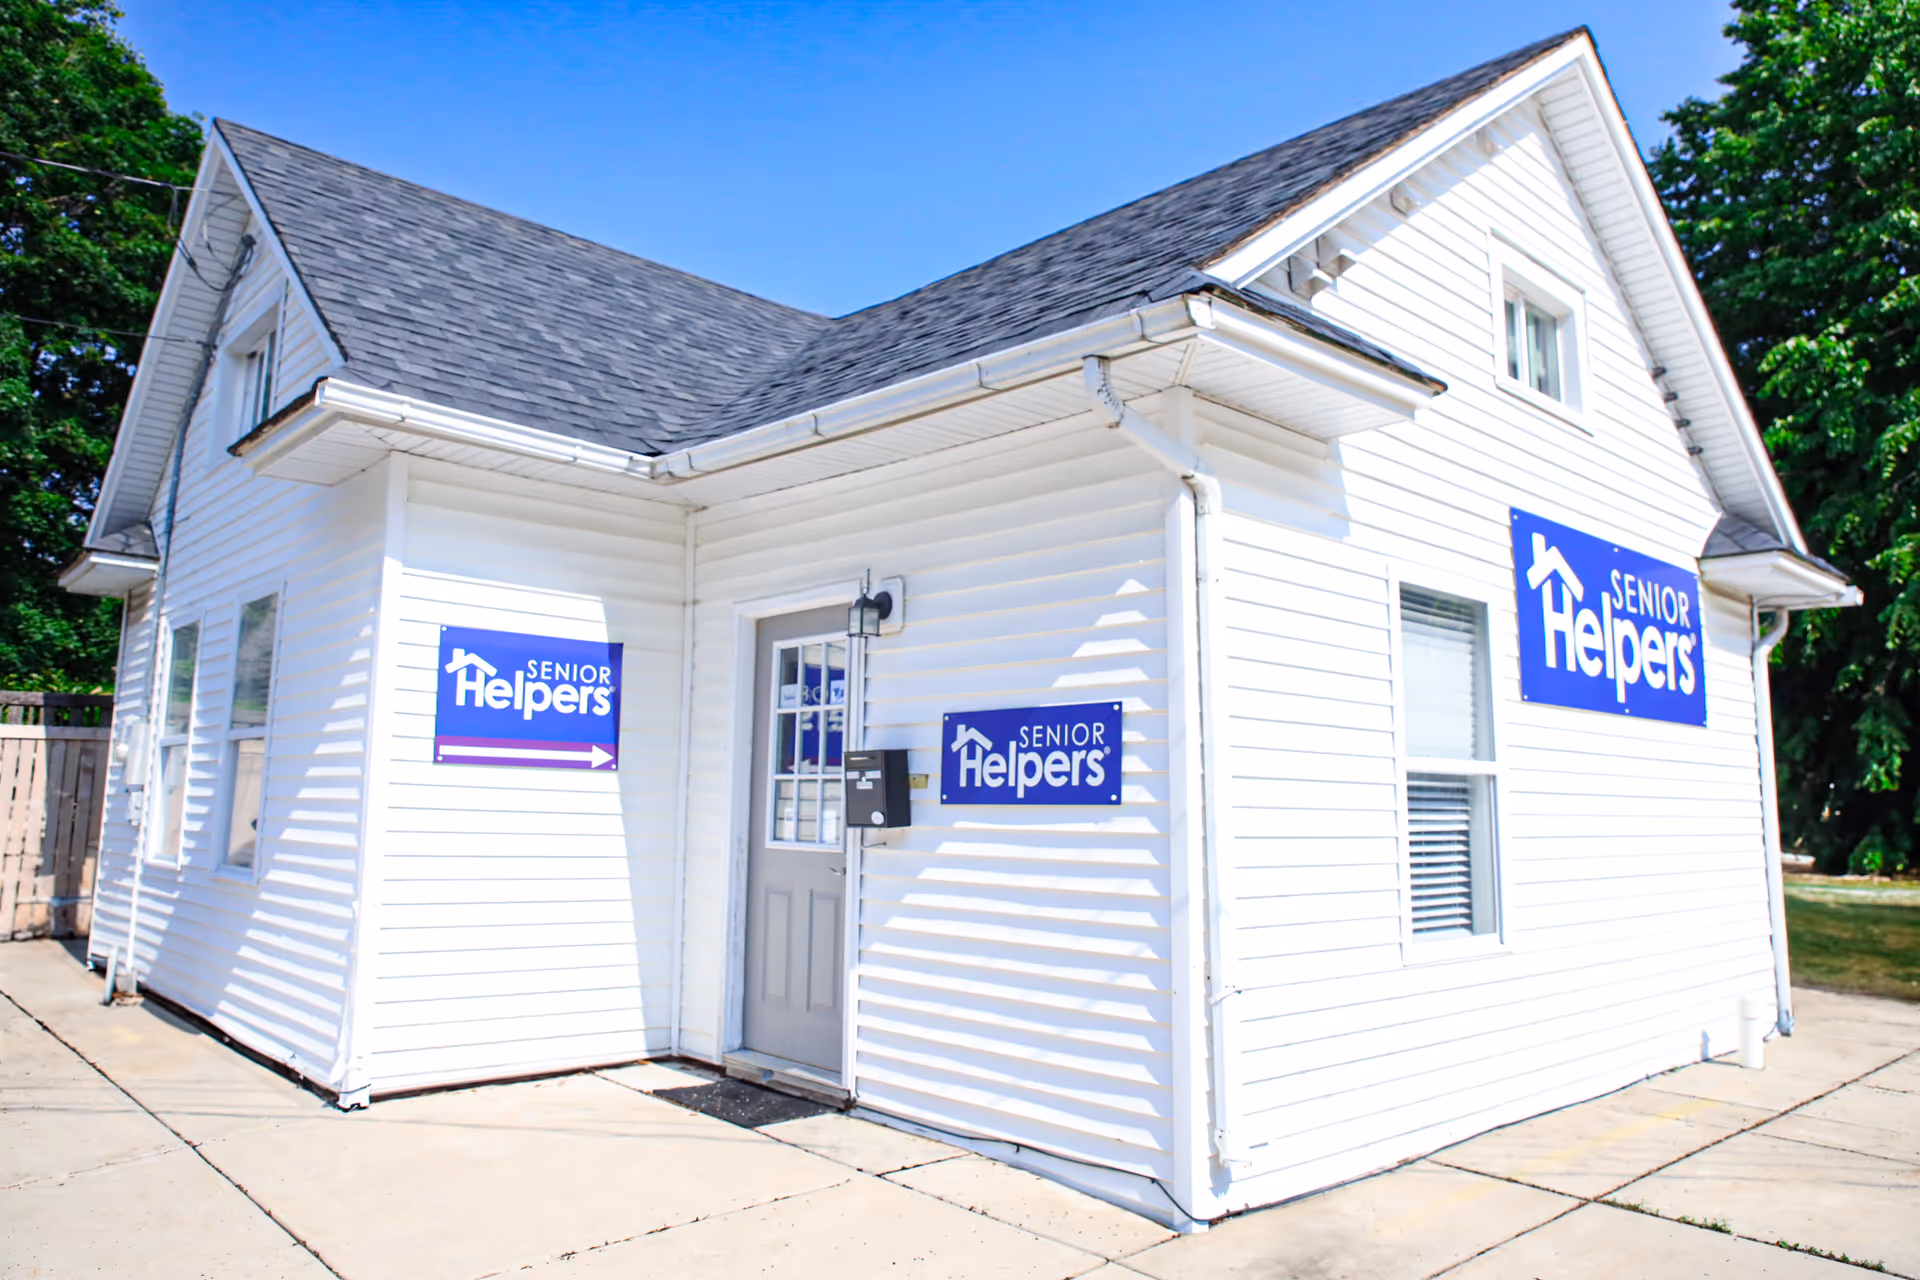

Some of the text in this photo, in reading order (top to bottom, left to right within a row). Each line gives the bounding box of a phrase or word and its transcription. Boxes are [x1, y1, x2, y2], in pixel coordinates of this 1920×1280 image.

[1610, 569, 1691, 629] SENIOR
[1541, 578, 1696, 704] Helpers
[455, 667, 612, 721] Helpers
[526, 659, 612, 685] SENIOR
[1019, 722, 1105, 749] SENIOR
[959, 740, 1106, 799] Helpers
